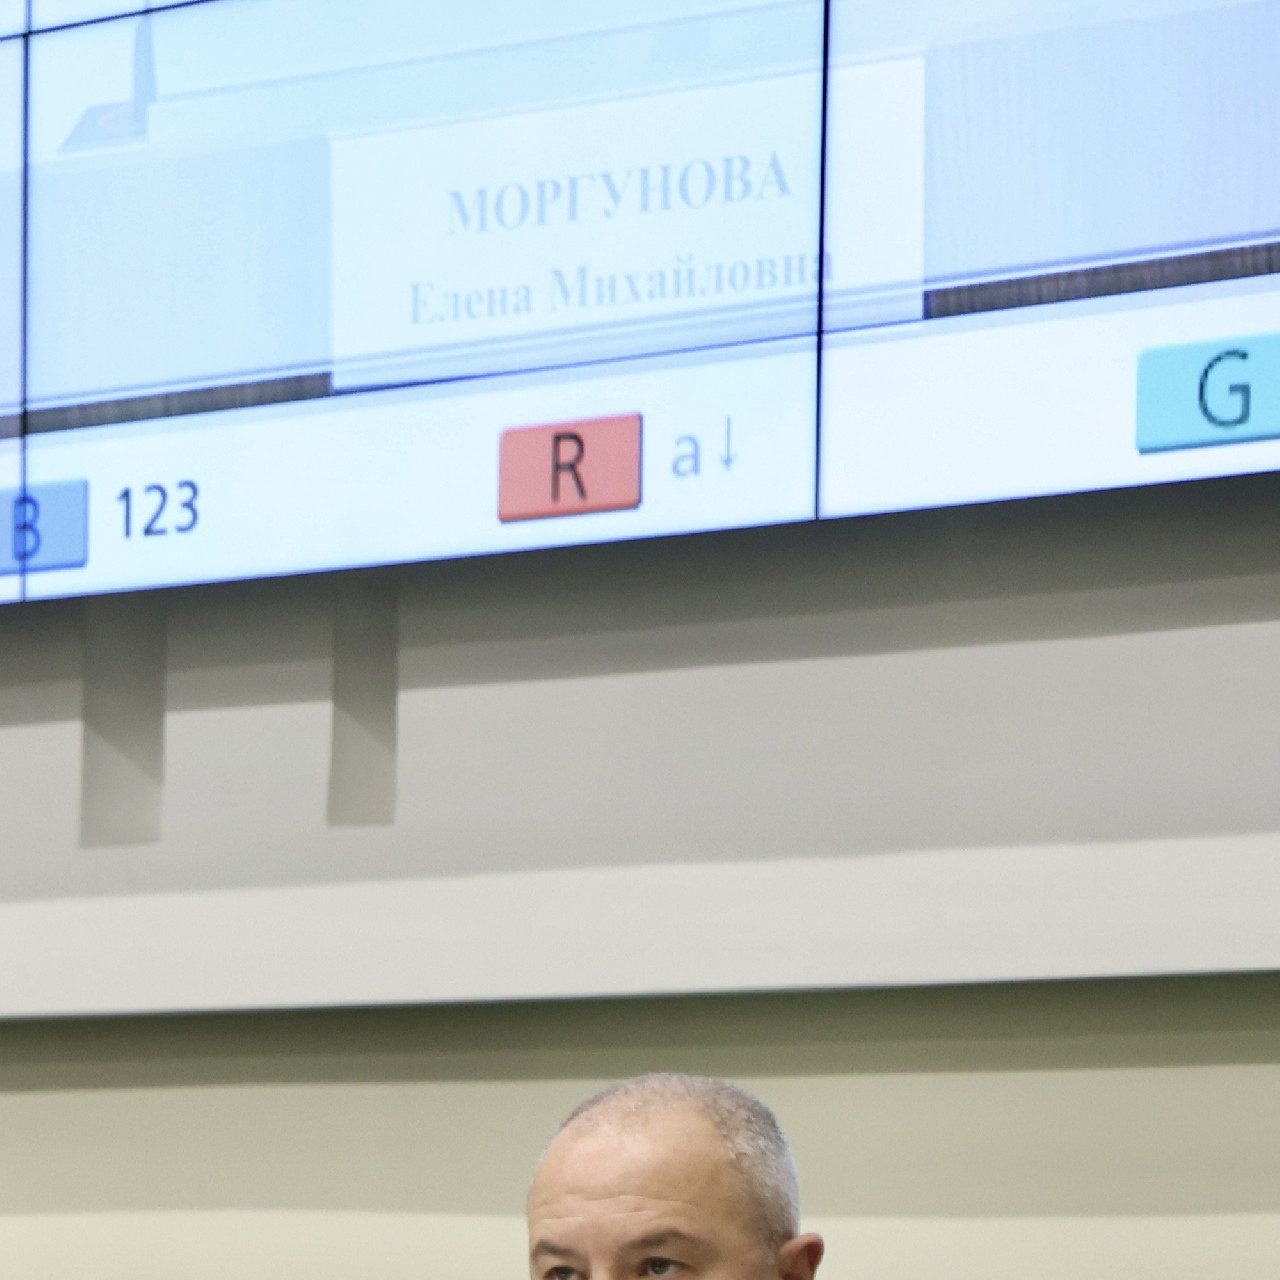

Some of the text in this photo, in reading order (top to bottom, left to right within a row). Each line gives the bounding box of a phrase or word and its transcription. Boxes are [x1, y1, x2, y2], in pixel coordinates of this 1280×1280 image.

[446, 152, 792, 236] МОРГУНОВА
[408, 277, 533, 326] Елена
[1198, 348, 1252, 429] G
[550, 431, 702, 503] R a
[13, 479, 201, 562] B 123
